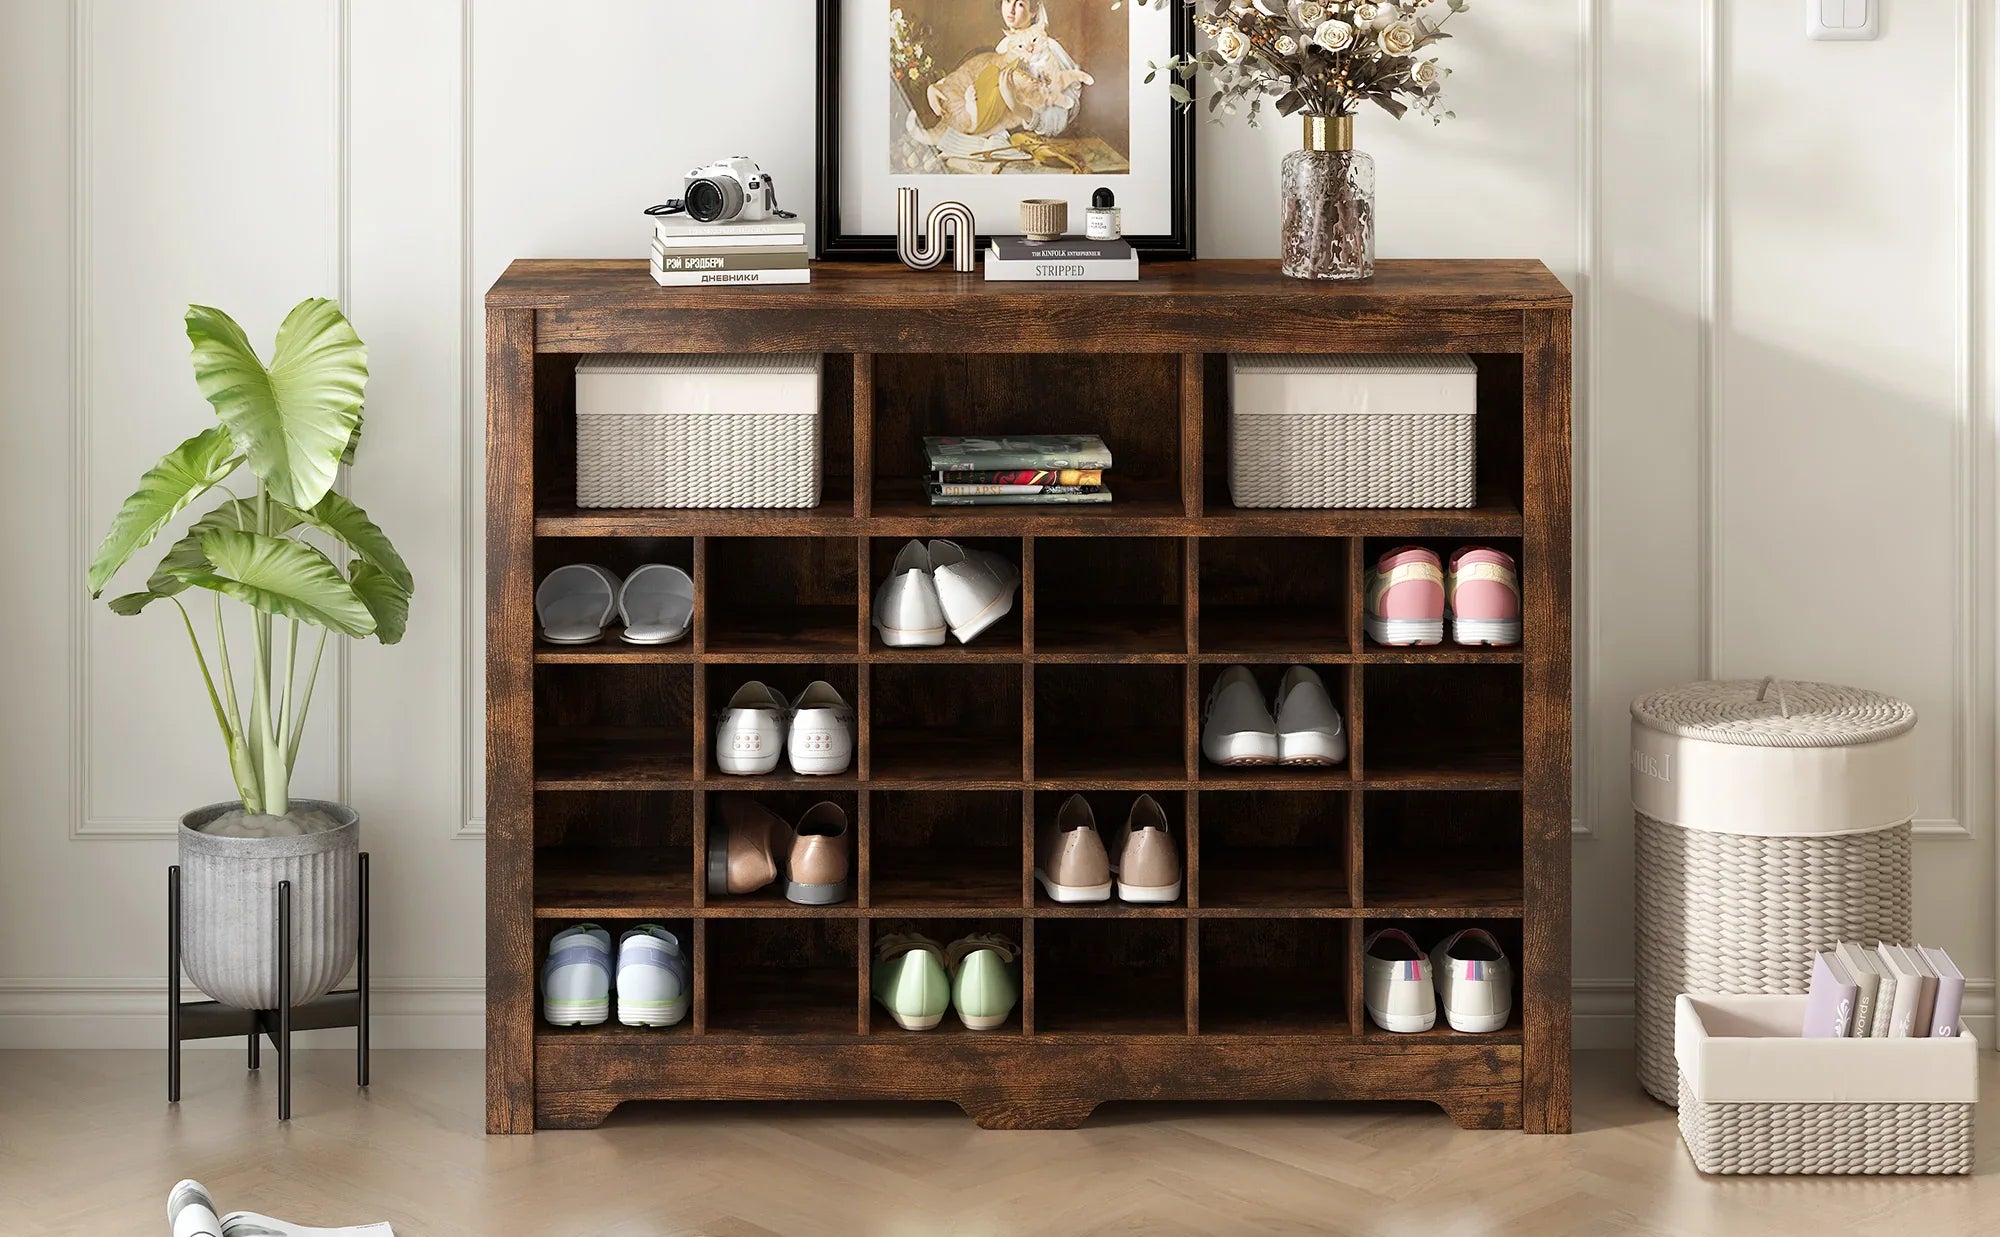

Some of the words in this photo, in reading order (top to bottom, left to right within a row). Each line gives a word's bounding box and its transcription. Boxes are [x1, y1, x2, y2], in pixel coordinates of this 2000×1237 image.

[666, 256, 682, 269] РЭЙ
[685, 257, 725, 269] БРЭДБЕРИ
[1035, 265, 1085, 277] STRIPPED
[701, 274, 759, 283] ДНЕВНИКИ
